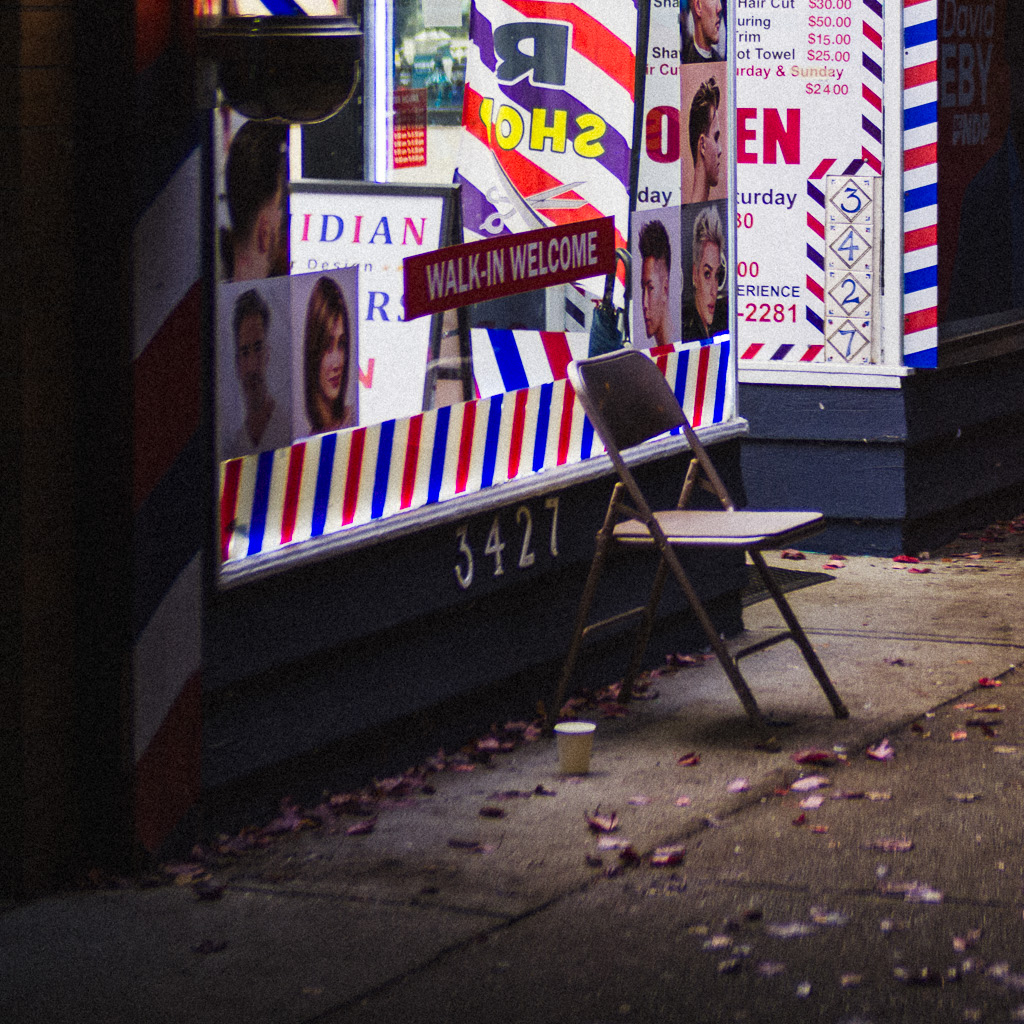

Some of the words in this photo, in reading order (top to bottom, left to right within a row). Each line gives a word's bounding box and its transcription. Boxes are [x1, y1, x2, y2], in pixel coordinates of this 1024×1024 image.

[808, 15, 851, 28] $50.00
[755, 48, 796, 60] Towel
[807, 49, 851, 62] $25.00
[808, 33, 851, 45] $15.00
[776, 66, 786, 77] &
[791, 65, 844, 80] Sunday
[940, 42, 994, 108] EBY
[646, 105, 800, 165] OEN
[291, 214, 428, 246] IDIAN
[426, 252, 503, 300] WALK-IN
[510, 231, 598, 281] WELCOME
[455, 498, 560, 589] 3427
